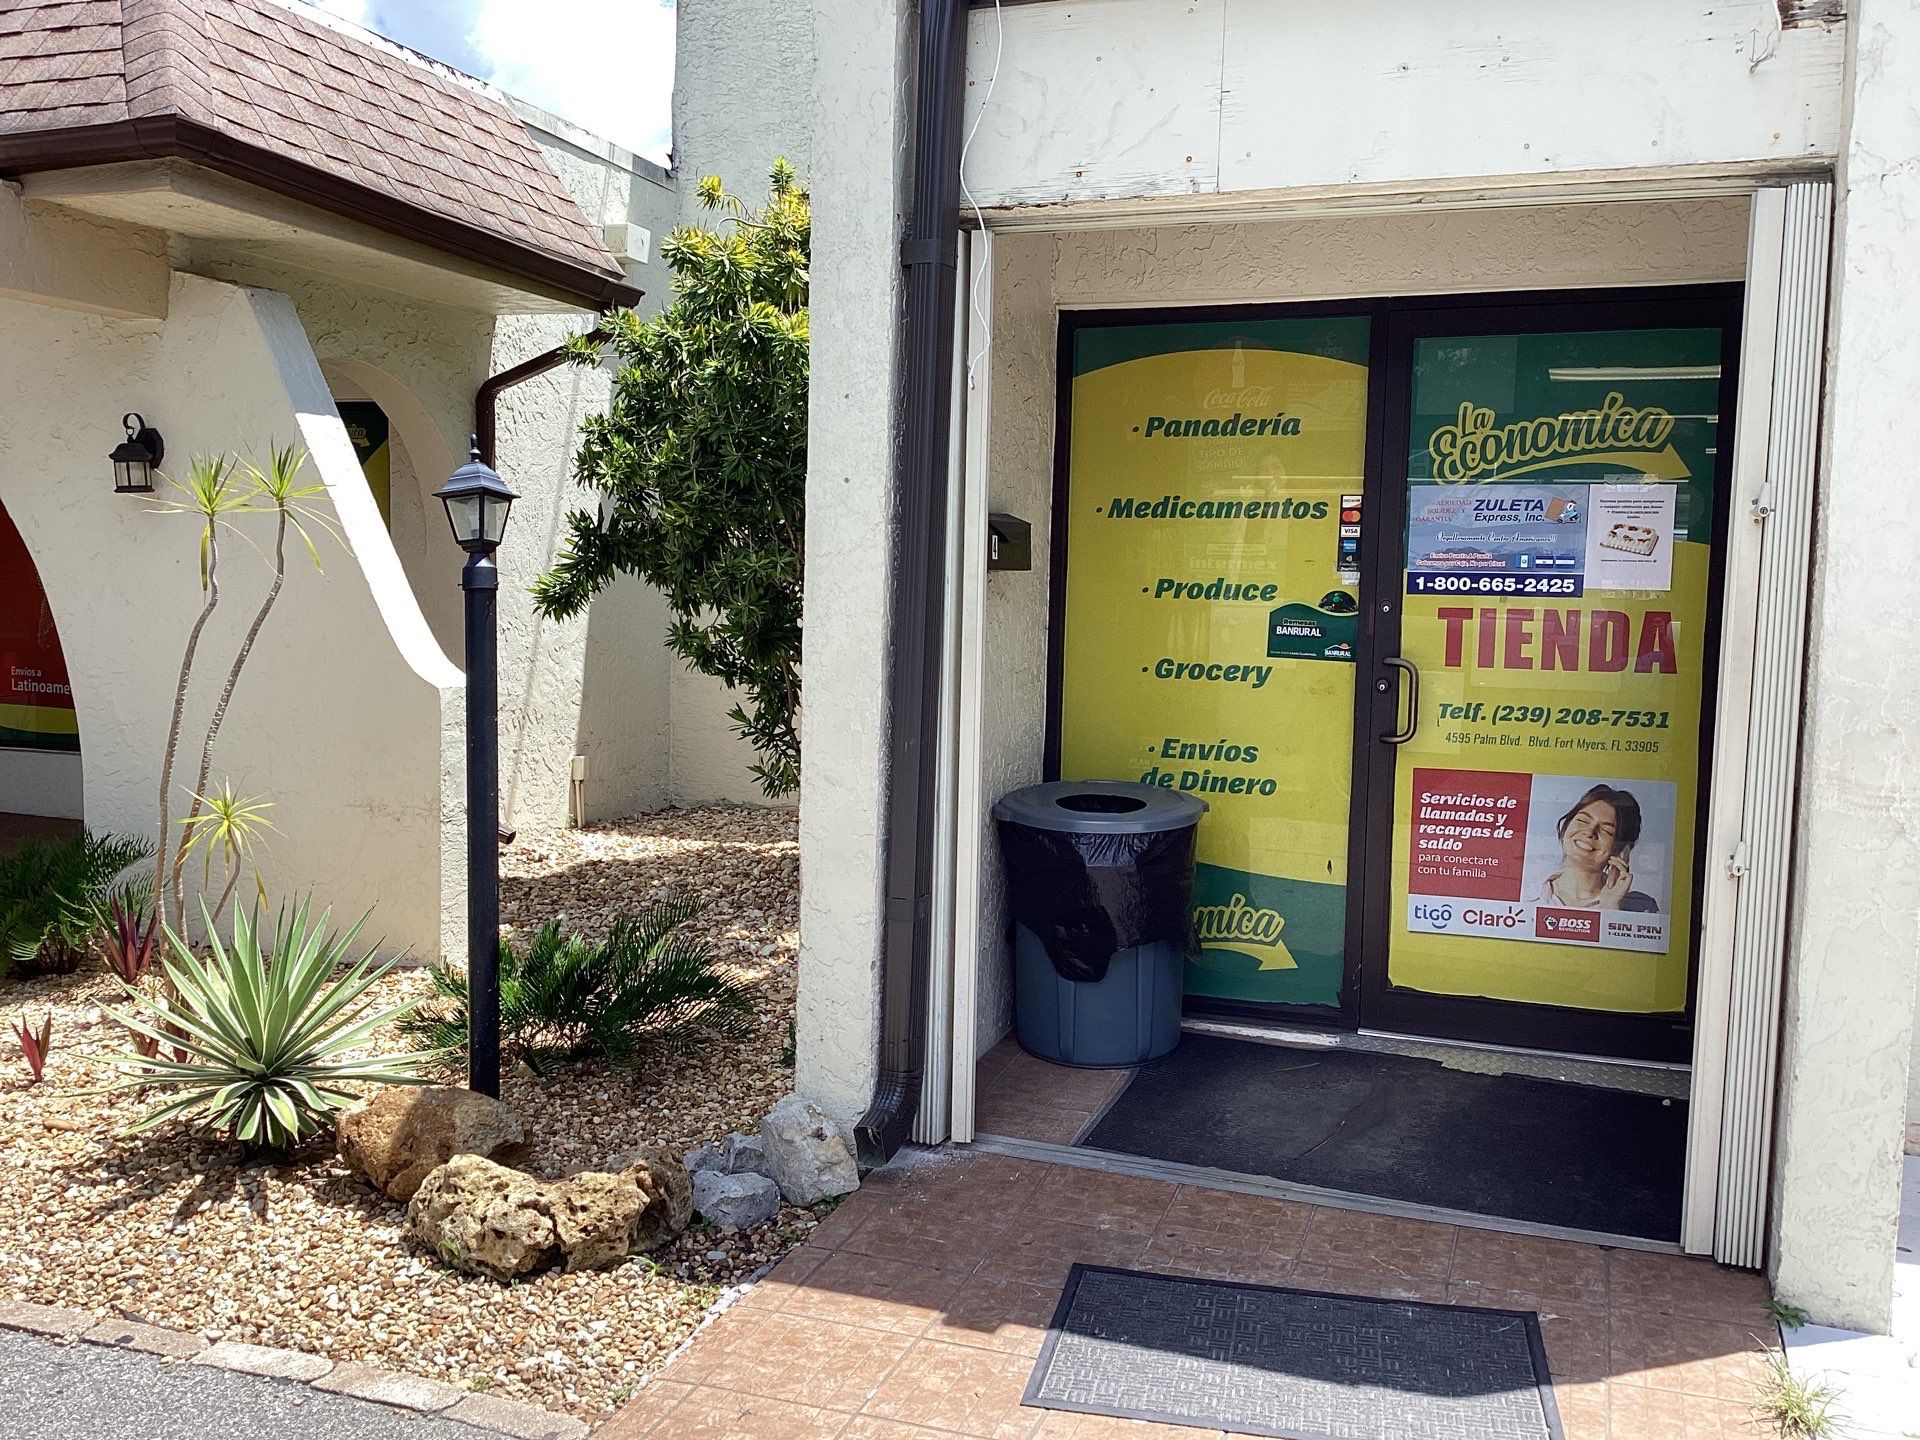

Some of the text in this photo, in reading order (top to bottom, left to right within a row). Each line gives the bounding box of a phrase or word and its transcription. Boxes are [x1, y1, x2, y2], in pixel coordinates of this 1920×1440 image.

[1145, 412, 1301, 438] Panadería
[1458, 402, 1495, 437] La
[1429, 391, 1675, 486] Economica
[1107, 496, 1328, 519] Medicamentos
[1472, 499, 1544, 512] ZULETA
[1474, 513, 1545, 523] Express, Inc.
[1154, 578, 1278, 601] Produce
[1416, 576, 1575, 593] 1-800-665-2425
[1276, 626, 1322, 637] BANRURAL
[1283, 618, 1317, 627] Remesas
[1438, 607, 1678, 674] TIENDA
[1324, 649, 1351, 657] BANRURAL
[1154, 658, 1273, 689] Grocery
[12, 678, 70, 694] Latinoame
[1439, 703, 1669, 728] Telf. (239) 208-7531
[1161, 739, 1258, 763] Envíos
[1445, 732, 1471, 743] 4595
[1473, 734, 1497, 745] Palm
[1500, 735, 1522, 746] Blvd.
[1529, 736, 1551, 747] Blvd.
[1554, 738, 1573, 748] Fort
[1611, 740, 1621, 751] FL
[1625, 741, 1659, 752] 33905
[1140, 767, 1277, 796] de Dinero
[1420, 792, 1517, 808] Servicios de
[1420, 807, 1507, 826] llamadas y
[1419, 824, 1514, 839] recargas de
[1418, 838, 1463, 851] saldo
[1419, 853, 1499, 867] para conectarte
[1418, 866, 1487, 878] con tu familia
[1194, 892, 1285, 942] mica
[1462, 907, 1517, 928] Claro
[1558, 917, 1592, 930] BOSS
[1608, 922, 1662, 935] SIN PIN
